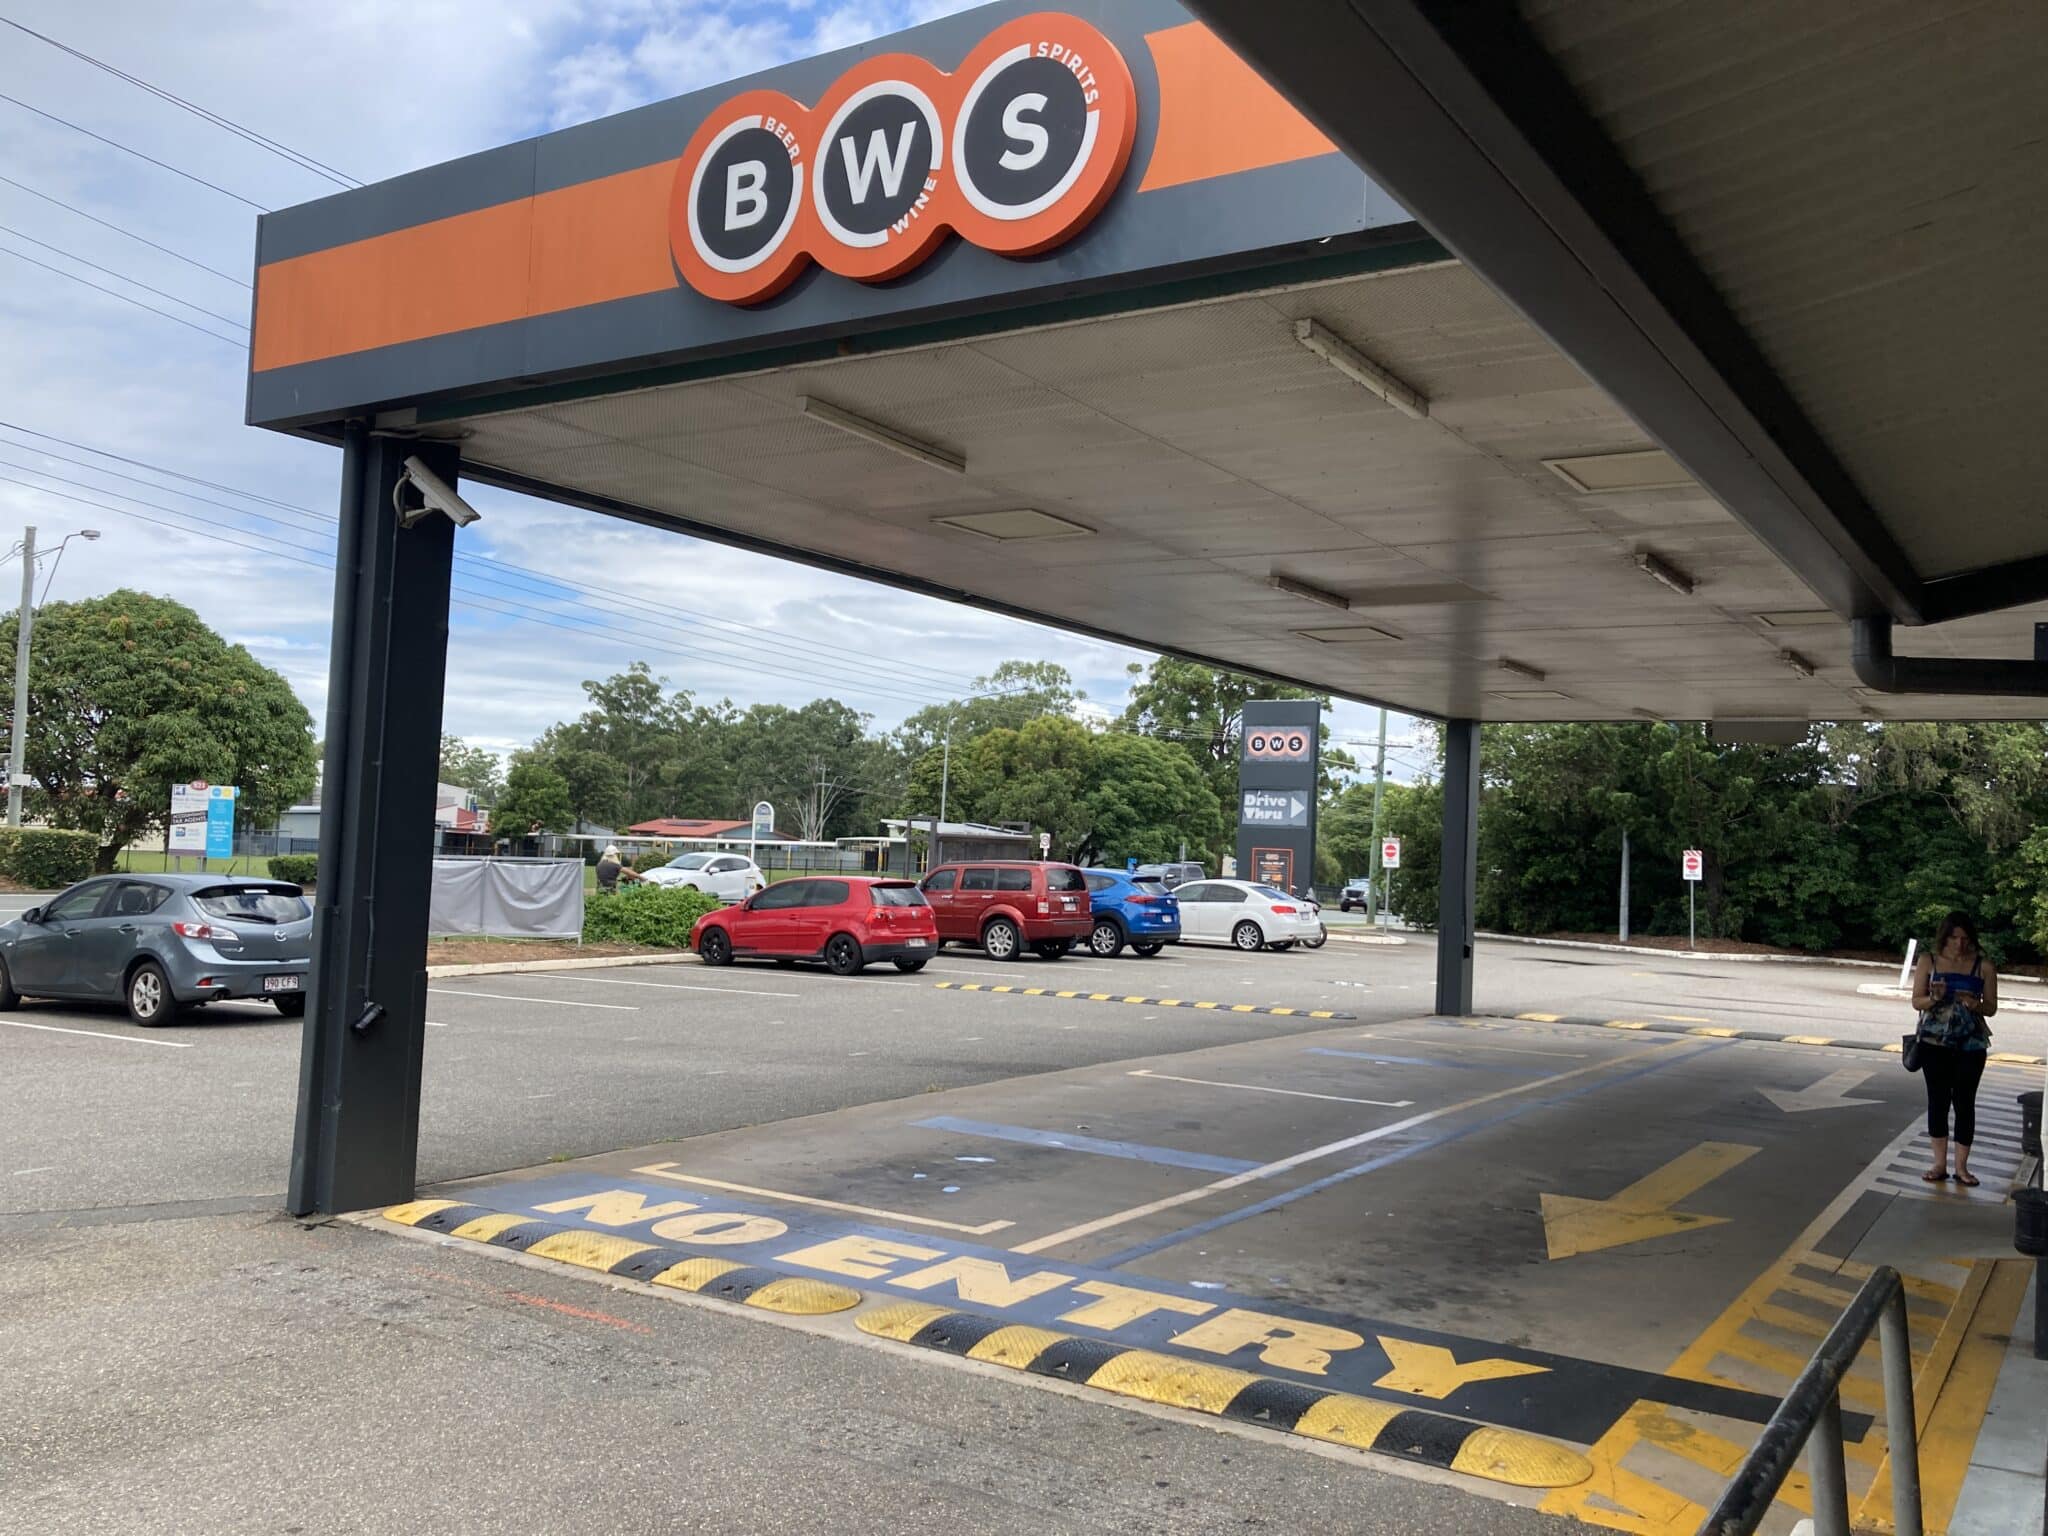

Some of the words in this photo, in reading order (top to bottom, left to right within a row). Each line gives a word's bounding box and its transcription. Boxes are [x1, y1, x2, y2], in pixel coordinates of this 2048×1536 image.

[1037, 41, 1099, 105] SPIRITS
[763, 116, 801, 160] BEER
[891, 176, 938, 236] WINE
[1244, 793, 1287, 807] Drive
[530, 1187, 790, 1246] NO
[772, 1233, 1555, 1400] ENTRY
